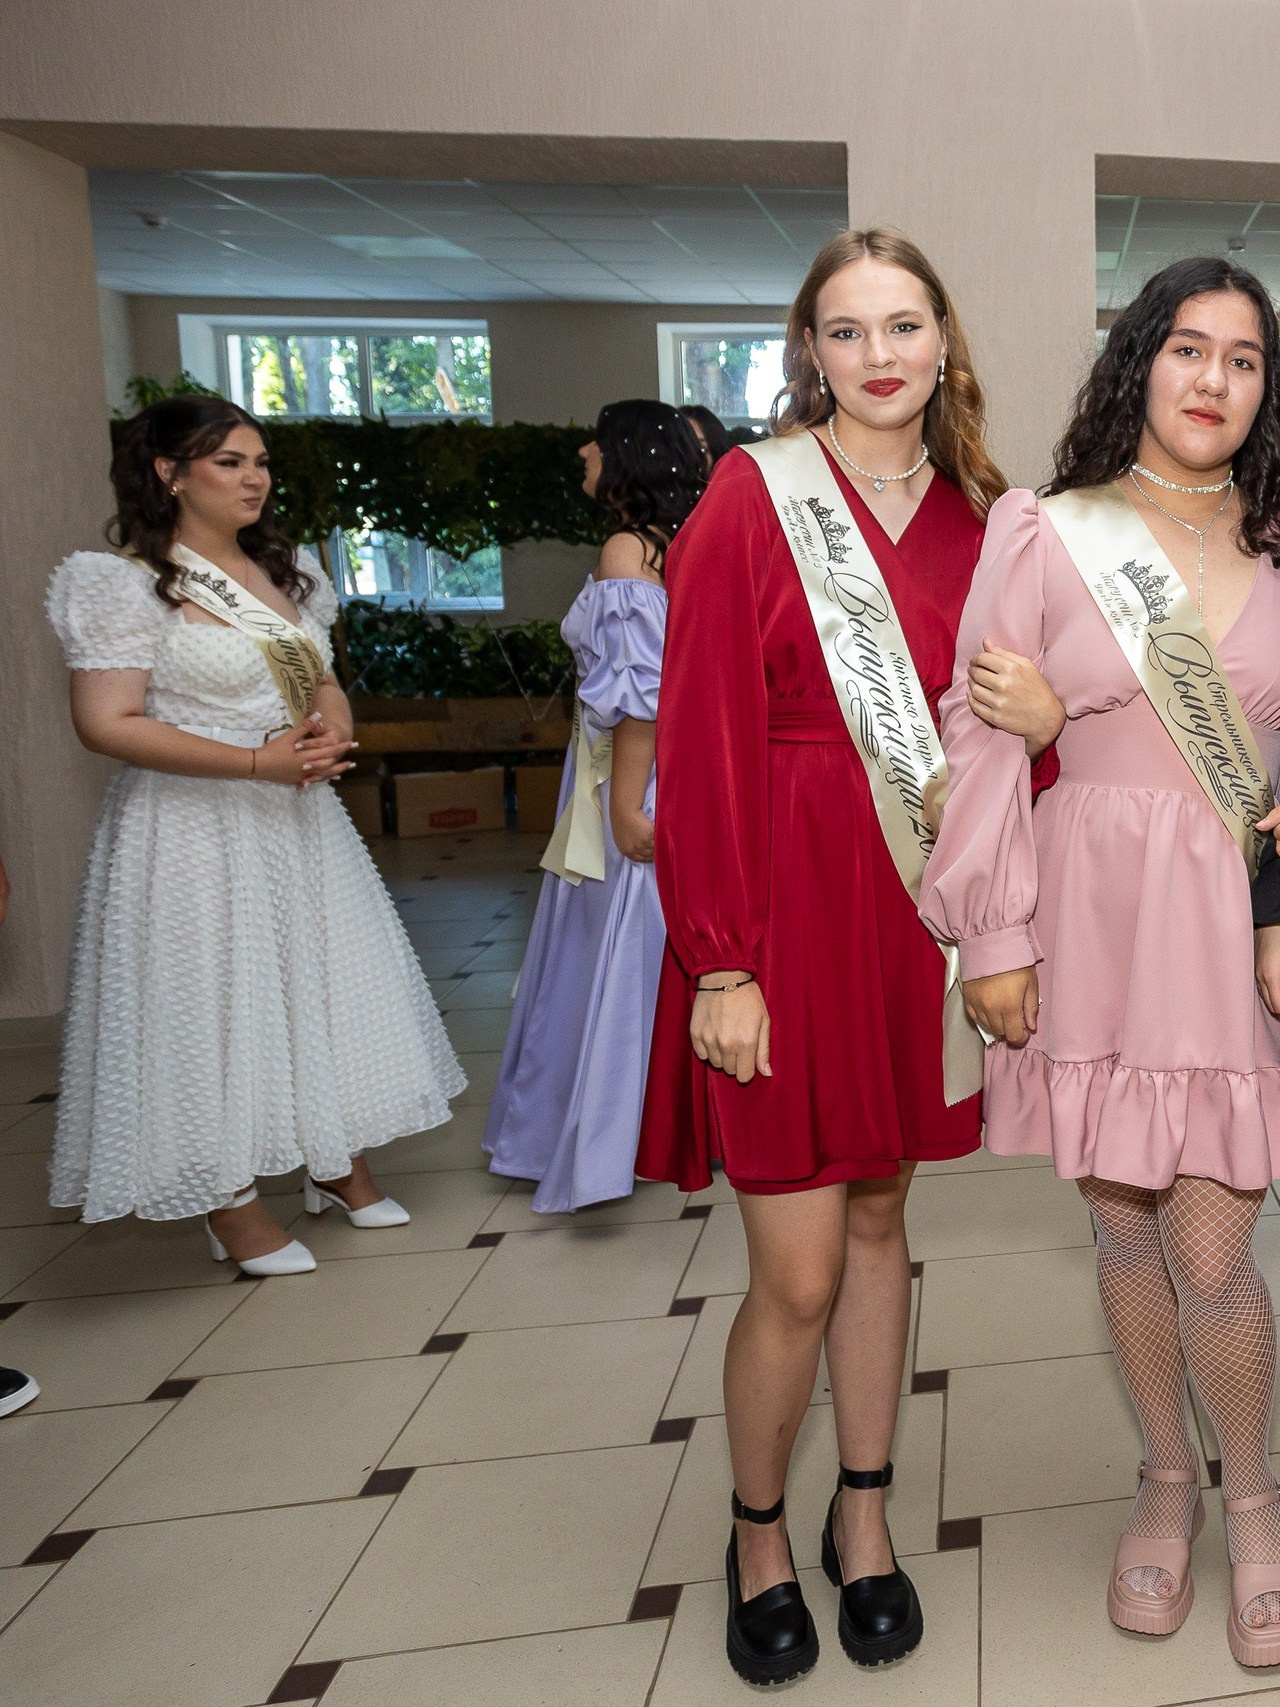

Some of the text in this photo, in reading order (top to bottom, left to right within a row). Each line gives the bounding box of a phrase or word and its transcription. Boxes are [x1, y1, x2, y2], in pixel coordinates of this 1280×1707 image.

[824, 566, 937, 860] Выпускница 20
[890, 650, 938, 779] Янченко Дарья
[1207, 674, 1262, 783] Стрельникова
